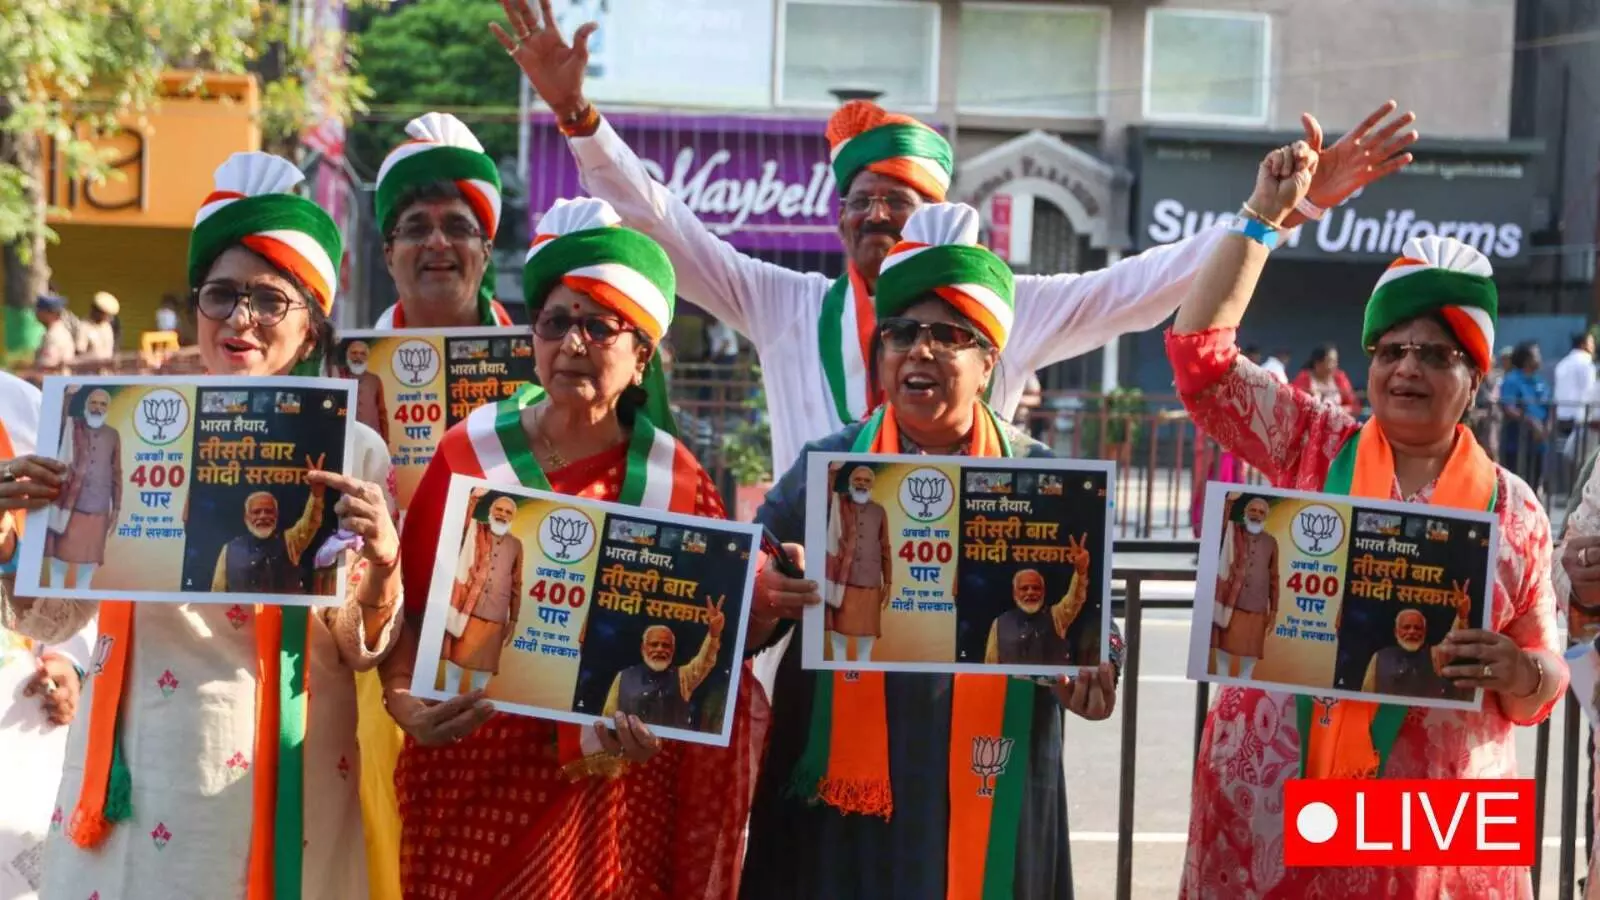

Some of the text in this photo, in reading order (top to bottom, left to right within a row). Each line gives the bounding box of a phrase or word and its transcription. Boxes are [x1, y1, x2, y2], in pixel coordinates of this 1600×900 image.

[641, 147, 837, 235] Maybell
[450, 364, 476, 375] भारत
[450, 377, 499, 398] तीसरी
[394, 403, 442, 424] 400
[200, 419, 231, 432] भारत
[404, 426, 431, 440] पार
[198, 435, 296, 461] तीसरी बार
[130, 464, 185, 488] 400
[196, 460, 241, 485] मोदी
[140, 491, 172, 509] पार
[965, 499, 997, 512] भारत
[964, 515, 1059, 539] तीसरी बार
[605, 546, 637, 562] भारत
[898, 540, 953, 563] 400
[964, 538, 1008, 563] मोदी
[1355, 537, 1384, 552] भारत
[910, 566, 941, 584] पार
[1352, 553, 1444, 583] तीसरी बार
[602, 564, 700, 599] तीसरी बार
[1286, 571, 1339, 597] 400
[1351, 575, 1393, 600] मोदी
[529, 579, 586, 608] 400
[598, 586, 643, 614] मोदी
[538, 606, 570, 628] पार
[1296, 597, 1326, 615] पार
